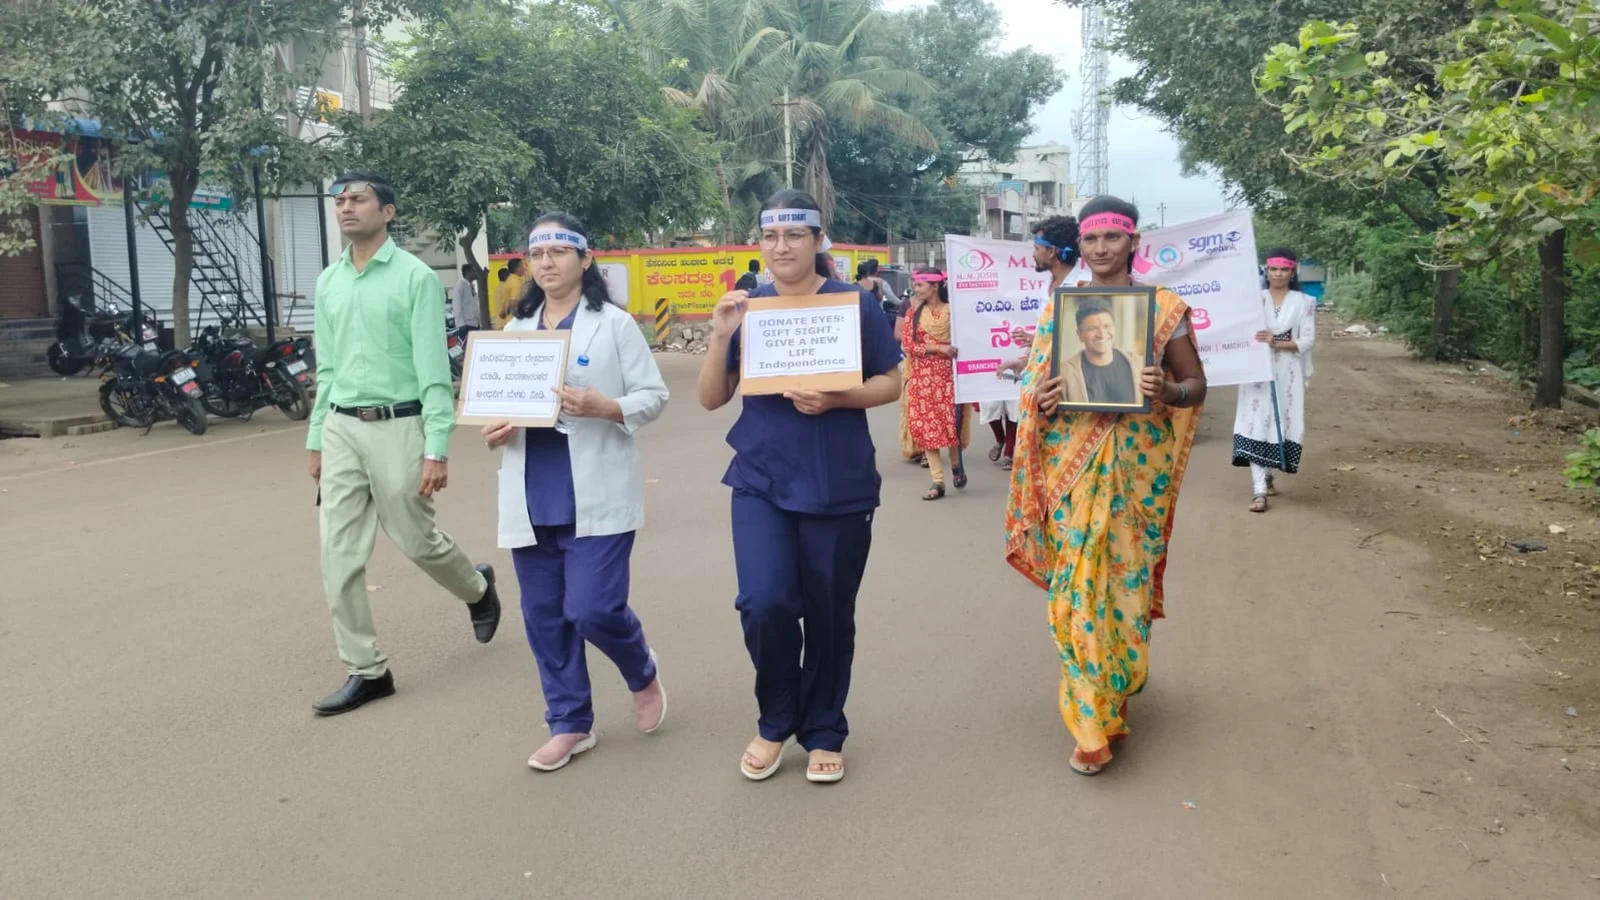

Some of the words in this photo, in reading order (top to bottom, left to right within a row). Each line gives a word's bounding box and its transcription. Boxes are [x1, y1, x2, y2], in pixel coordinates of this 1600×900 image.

[778, 214, 790, 222] GIFT
[791, 213, 807, 221] SIGHT
[1188, 233, 1223, 252] sgm
[646, 271, 715, 289] ಕೆಲಸದಲ್ಲಿ
[977, 271, 998, 280] JOSHI
[758, 316, 808, 327] DONATE
[811, 314, 846, 324] EYES:
[762, 328, 792, 337] GIFT
[795, 326, 832, 336] SIGHT
[765, 338, 796, 348] GIVE
[798, 338, 807, 346] A
[810, 336, 839, 345] NEW
[789, 348, 816, 357] LIFE
[759, 357, 846, 370] Independence
[967, 362, 999, 371] BRANCHES
